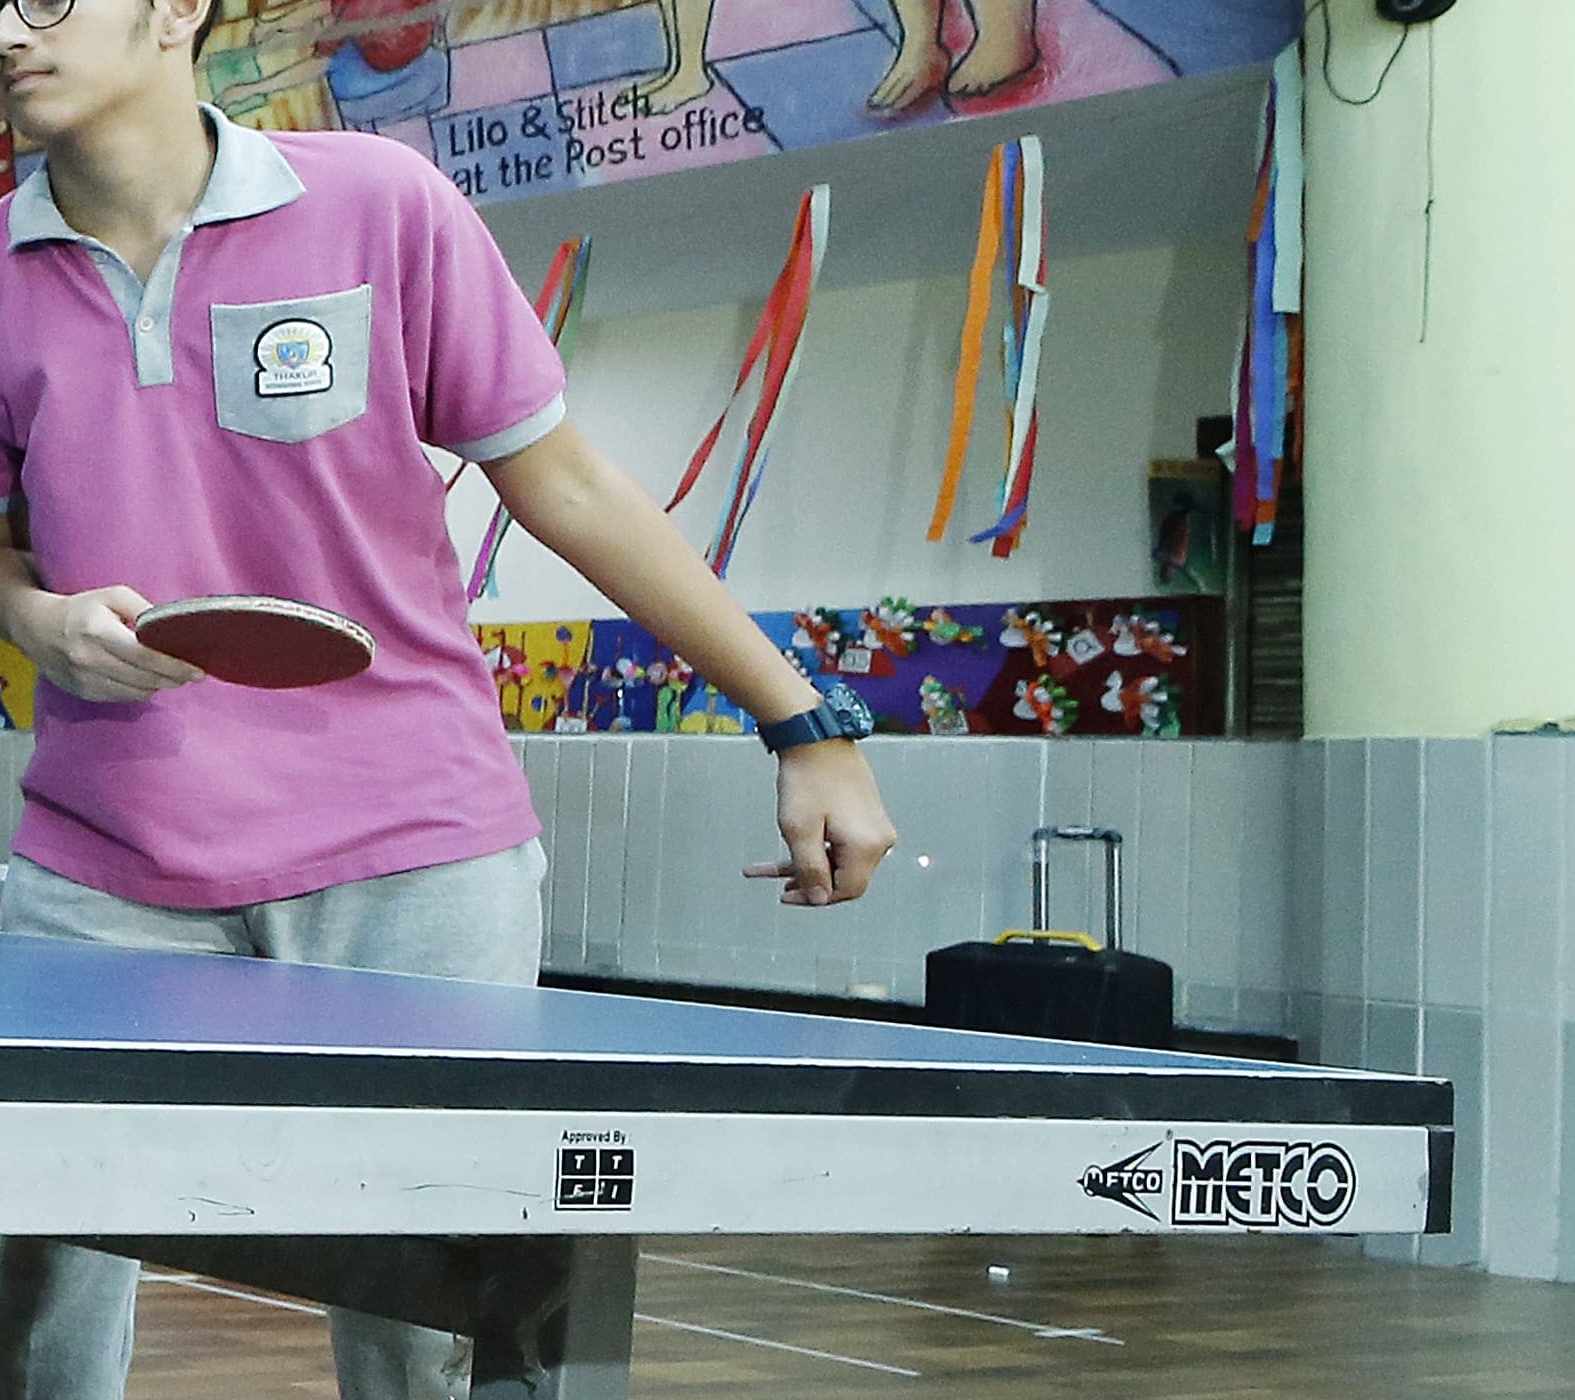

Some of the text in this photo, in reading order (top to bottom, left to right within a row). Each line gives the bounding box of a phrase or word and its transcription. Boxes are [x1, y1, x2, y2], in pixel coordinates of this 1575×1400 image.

[449, 84, 650, 156] Lilo & Stitch
[454, 107, 764, 197] at the Post office
[562, 1129, 610, 1143] Approved
[1172, 1139, 1357, 1227] METCO
